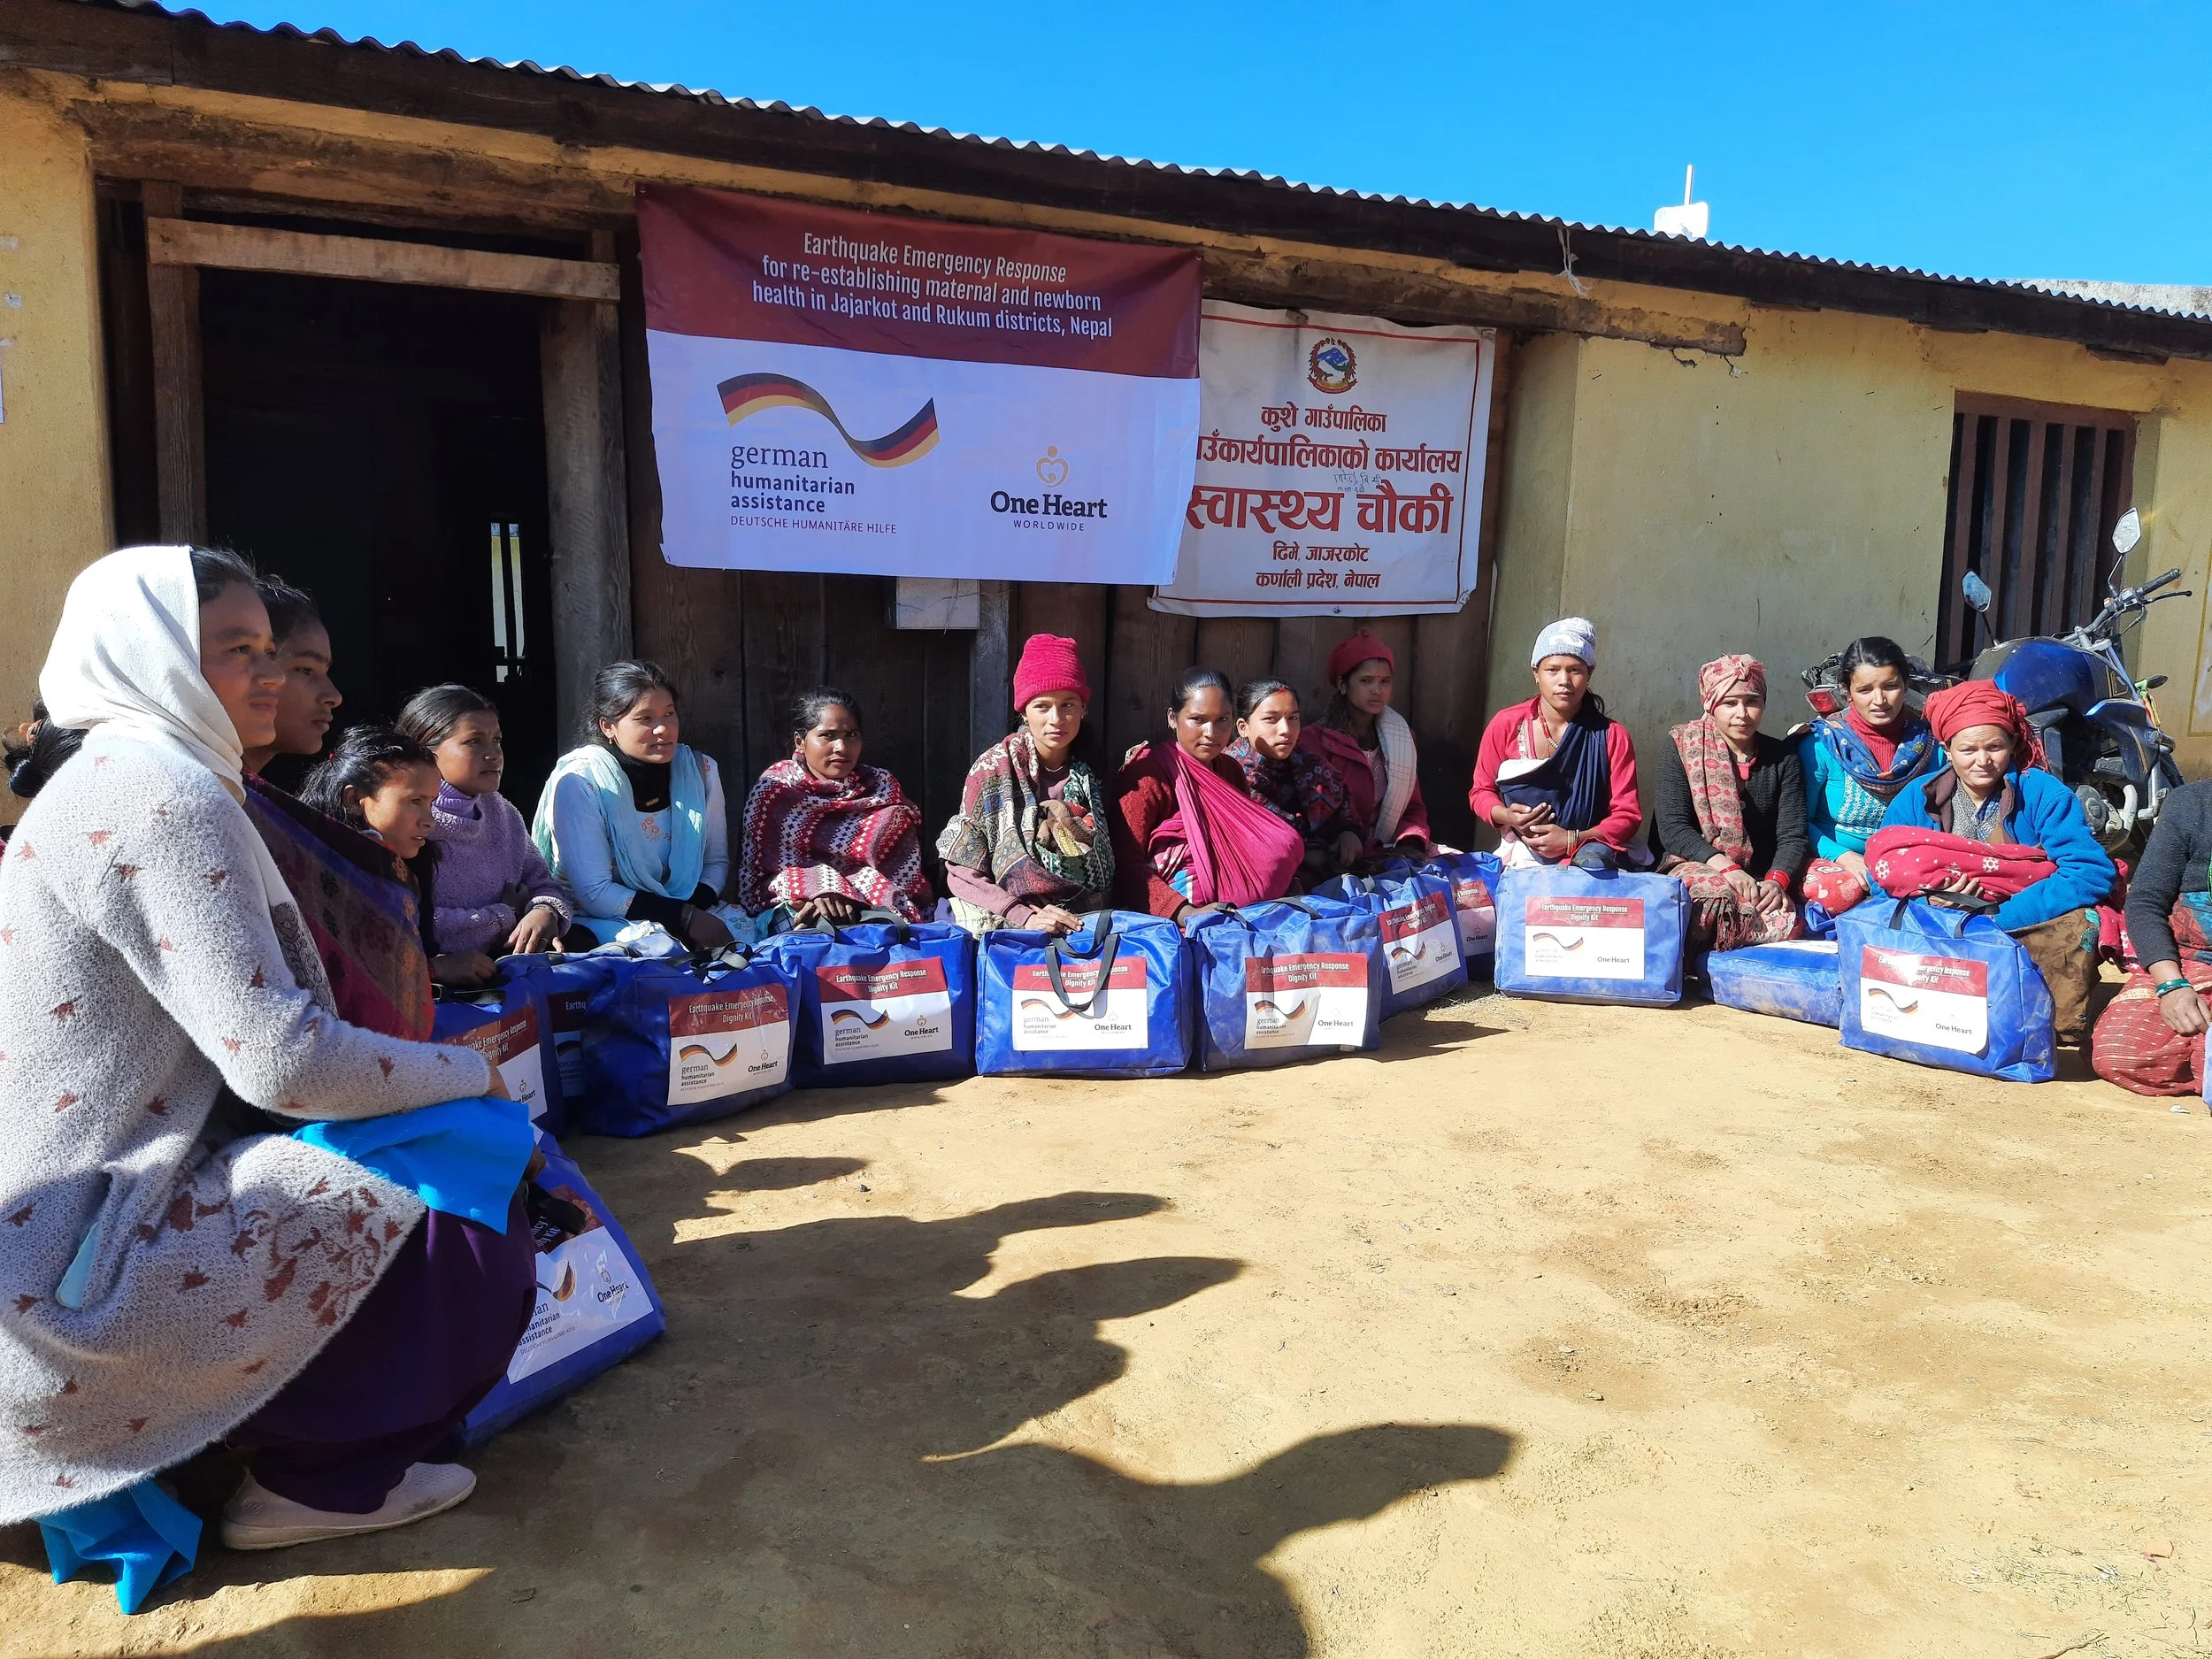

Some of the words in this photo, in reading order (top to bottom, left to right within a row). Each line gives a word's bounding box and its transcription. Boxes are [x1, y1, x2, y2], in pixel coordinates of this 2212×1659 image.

[804, 232, 898, 264] Earthquake
[903, 245, 992, 280] Emergency
[996, 257, 1066, 283] Response
[763, 254, 787, 278] for
[793, 263, 920, 299] re-establishing
[926, 278, 997, 303] maternal
[1002, 285, 1029, 306] and
[1034, 289, 1102, 311] newborn
[752, 280, 805, 309] health
[810, 287, 826, 311] in
[831, 292, 898, 319] Jajarkot
[902, 303, 930, 323] and
[936, 304, 990, 328] Rukum
[995, 309, 1065, 337] districts,
[1071, 316, 1113, 340] Nepal
[1261, 401, 1299, 432] कुशे
[1304, 403, 1387, 433] गाउँपालिका
[730, 445, 828, 469] german
[1196, 428, 1370, 470] ाउँकार्यपालिकाको
[1375, 442, 1462, 473] कार्यालय
[731, 470, 855, 495] humanitarian
[731, 492, 826, 512] assistance
[990, 490, 1039, 515] One
[1041, 494, 1108, 518] Heart
[1186, 485, 1345, 534] स्वास्थ्य
[1356, 479, 1454, 534] चौकी
[731, 515, 788, 527] DEUTSCHE
[792, 518, 864, 532] HUMANITÄRE
[867, 523, 897, 534] HILFE
[1013, 519, 1085, 531] WORLDWIDE
[1305, 542, 1370, 562] जाजरकोट
[1256, 568, 1302, 588] कर्णाली
[1343, 569, 1381, 588] नेपाल
[1541, 903, 1571, 912] Earthquake
[1570, 913, 1590, 922] Dignity
[1288, 962, 1320, 972] Emergency
[1321, 962, 1349, 971] Response
[836, 973, 868, 983] Earthquake
[867, 972, 899, 982] Emergency
[900, 969, 927, 979] Response
[1067, 970, 1100, 979] Emergency
[1287, 973, 1308, 983] Dignity
[1930, 975, 1939, 984] Kit
[867, 984, 889, 995] Dignity
[889, 981, 899, 990] Kit
[1064, 979, 1087, 987] Dignity
[565, 1000, 587, 1010] Earthq
[689, 1002, 723, 1014] Earthquake
[725, 999, 753, 1010] Emergency
[722, 1013, 744, 1024] Dignity
[482, 1029, 510, 1047] Emergency
[510, 1019, 527, 1034] Response
[834, 1026, 861, 1036] german
[919, 1026, 939, 1035] Heart
[1951, 1025, 1972, 1034] Heart
[681, 1064, 709, 1074] german
[748, 1064, 760, 1073] One
[761, 1061, 778, 1070] Heart
[681, 1071, 715, 1080] humanitarian
[521, 1089, 536, 1102] Heart
[597, 1290, 611, 1302] One
